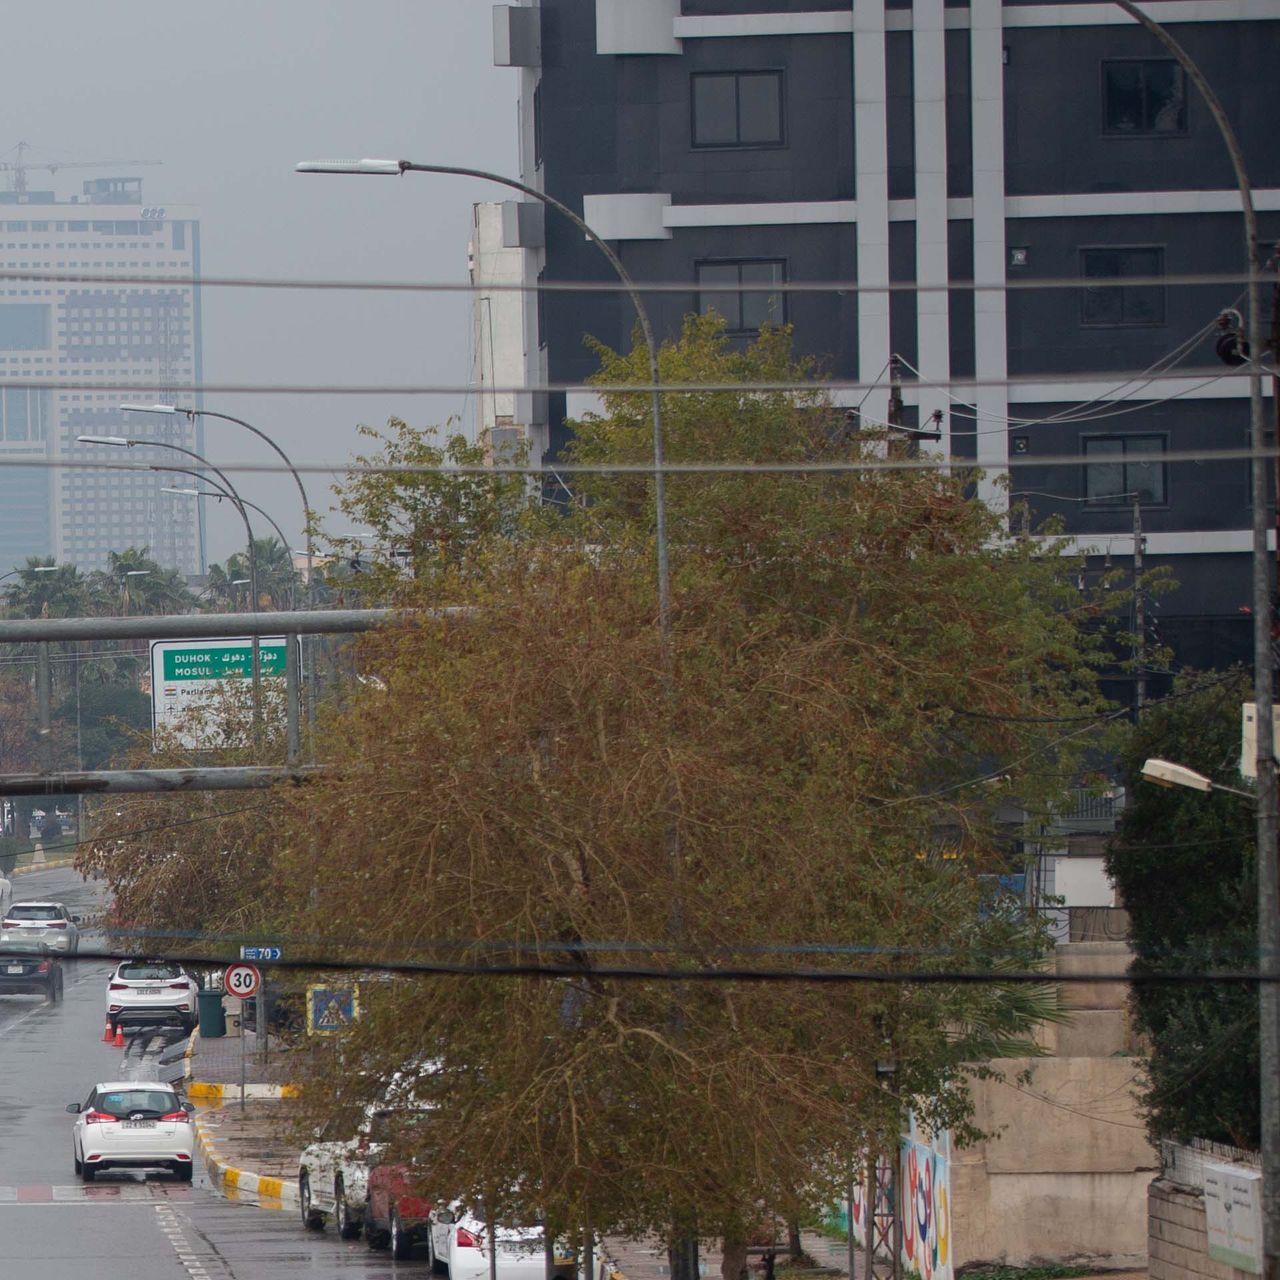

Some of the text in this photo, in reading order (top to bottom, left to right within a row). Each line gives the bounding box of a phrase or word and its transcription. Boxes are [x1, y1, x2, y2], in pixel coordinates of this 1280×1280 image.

[174, 654, 211, 664] DUHOK
[174, 667, 211, 677] MOSUL
[258, 948, 272, 960] 70
[233, 973, 252, 988] 30
